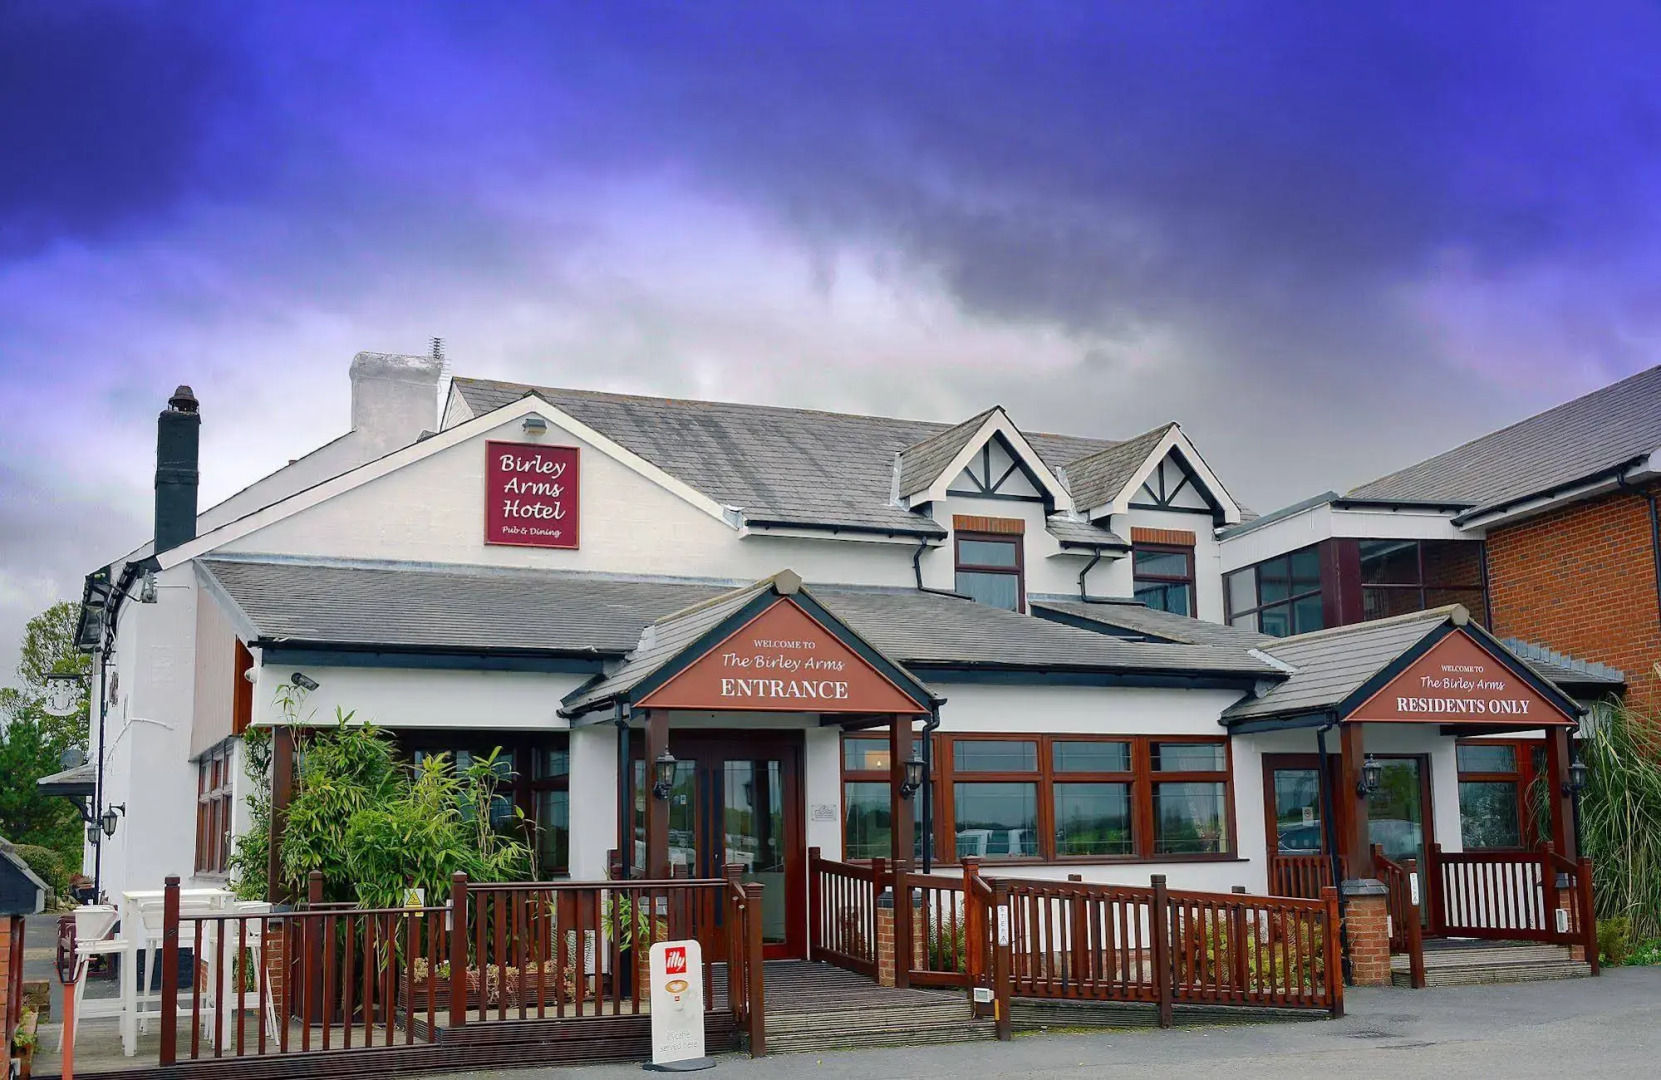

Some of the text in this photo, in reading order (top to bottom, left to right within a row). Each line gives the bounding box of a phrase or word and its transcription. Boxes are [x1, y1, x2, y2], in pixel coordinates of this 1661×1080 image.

[499, 454, 567, 480] Birley
[503, 477, 565, 498] Arms
[503, 499, 566, 520] Hotel
[502, 526, 562, 538] Pub & Dining
[753, 639, 816, 650] WELCOME TO
[722, 653, 845, 672] The Birley Arms
[1440, 664, 1484, 673] WELCOME TO
[720, 678, 849, 699] ENTRANCE
[1420, 675, 1506, 692] The Birley Arms
[1396, 697, 1531, 714] RESIDENTS ONLY
[666, 950, 686, 972] illy
